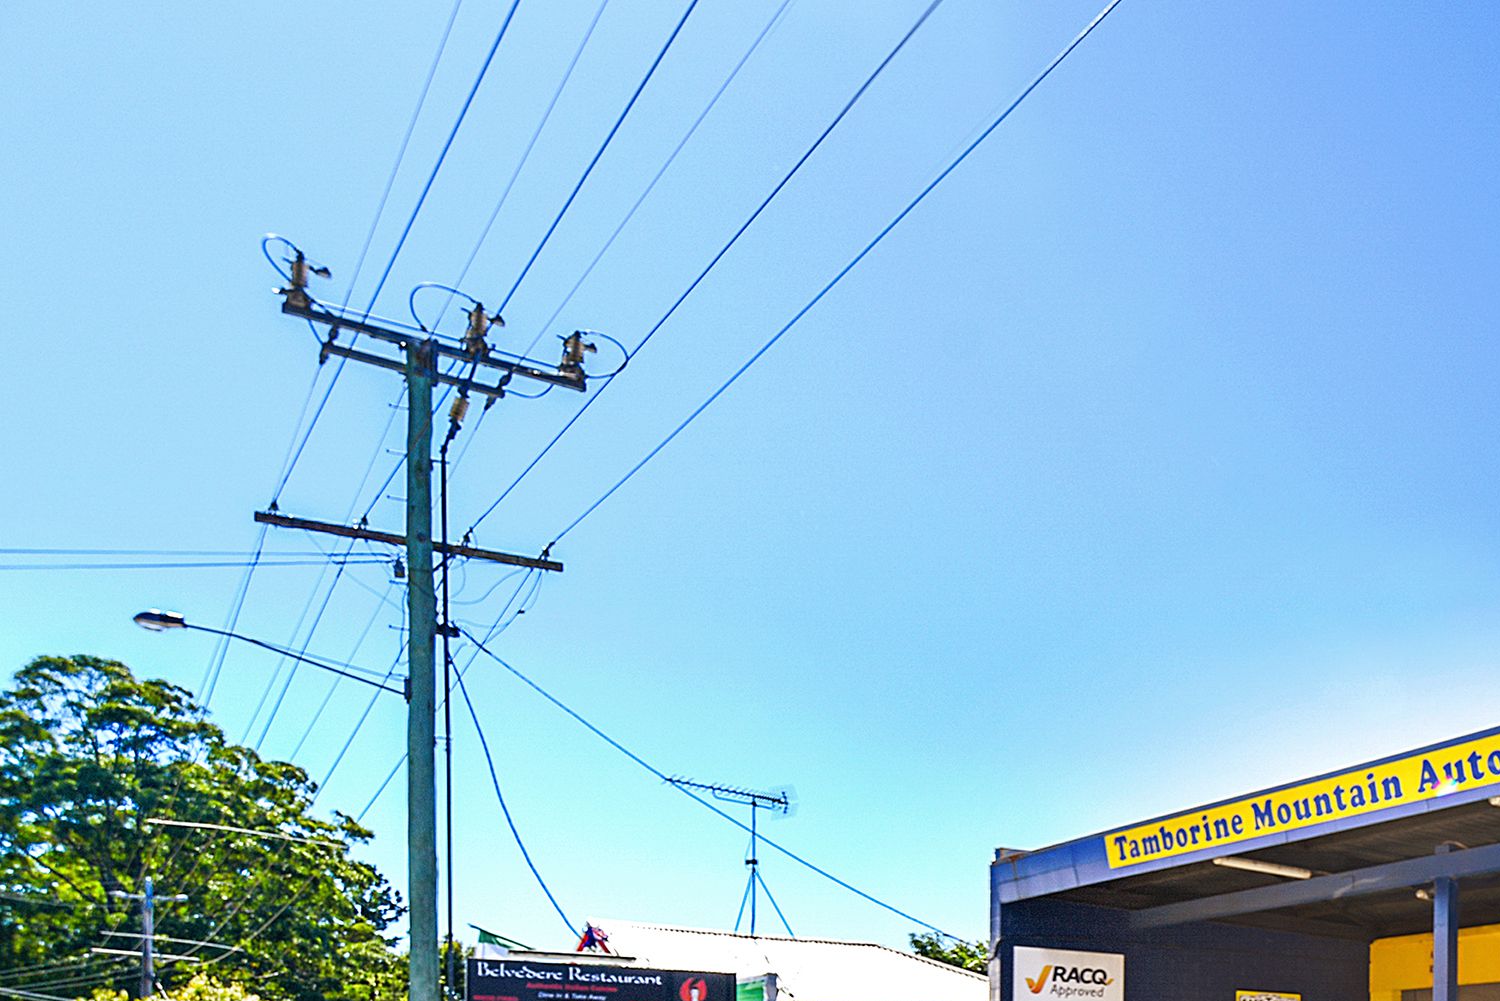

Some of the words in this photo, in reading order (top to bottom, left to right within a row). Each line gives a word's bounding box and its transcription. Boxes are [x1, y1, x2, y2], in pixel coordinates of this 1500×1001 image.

[1113, 814, 1244, 862] Tamborine
[1251, 774, 1404, 830] Mountain
[476, 960, 563, 981] Belvedere
[568, 966, 663, 986] Restaurant
[1052, 965, 1108, 986] RACQ
[1050, 984, 1105, 999] Approved
